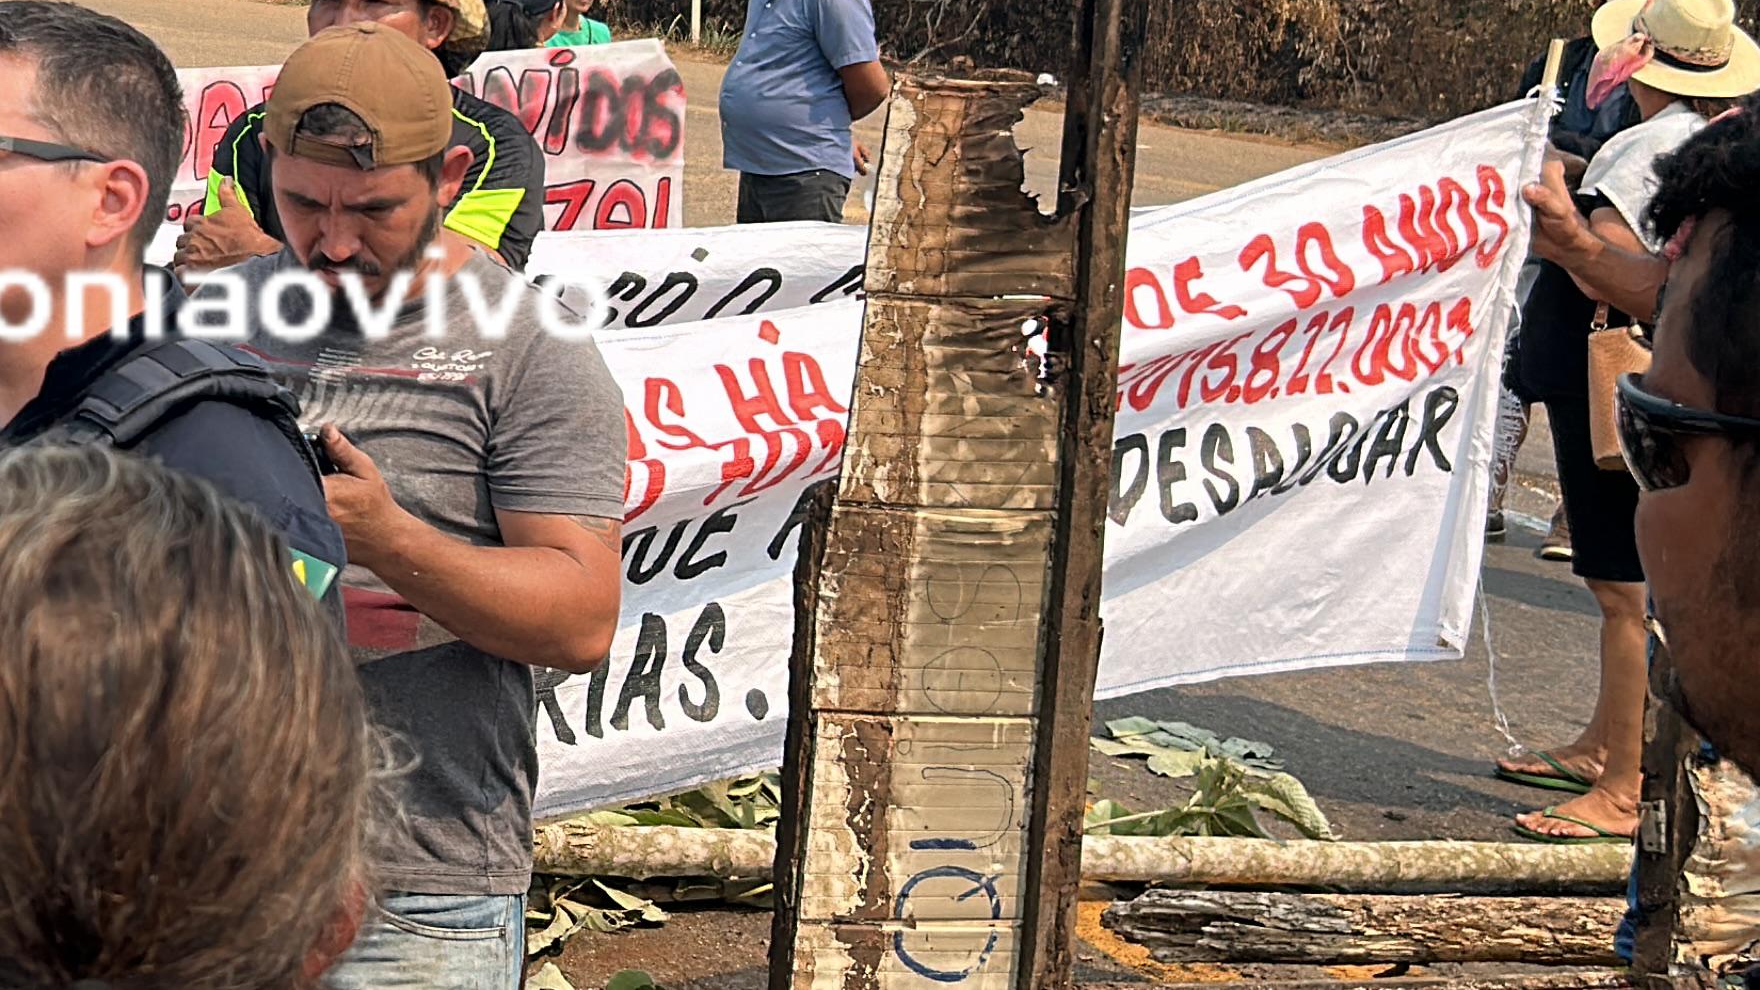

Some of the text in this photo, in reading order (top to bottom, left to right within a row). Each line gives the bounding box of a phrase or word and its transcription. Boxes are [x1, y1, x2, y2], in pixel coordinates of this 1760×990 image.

[1240, 222, 1355, 310] 30
[1361, 164, 1509, 284] ANOS
[622, 496, 759, 585] UE
